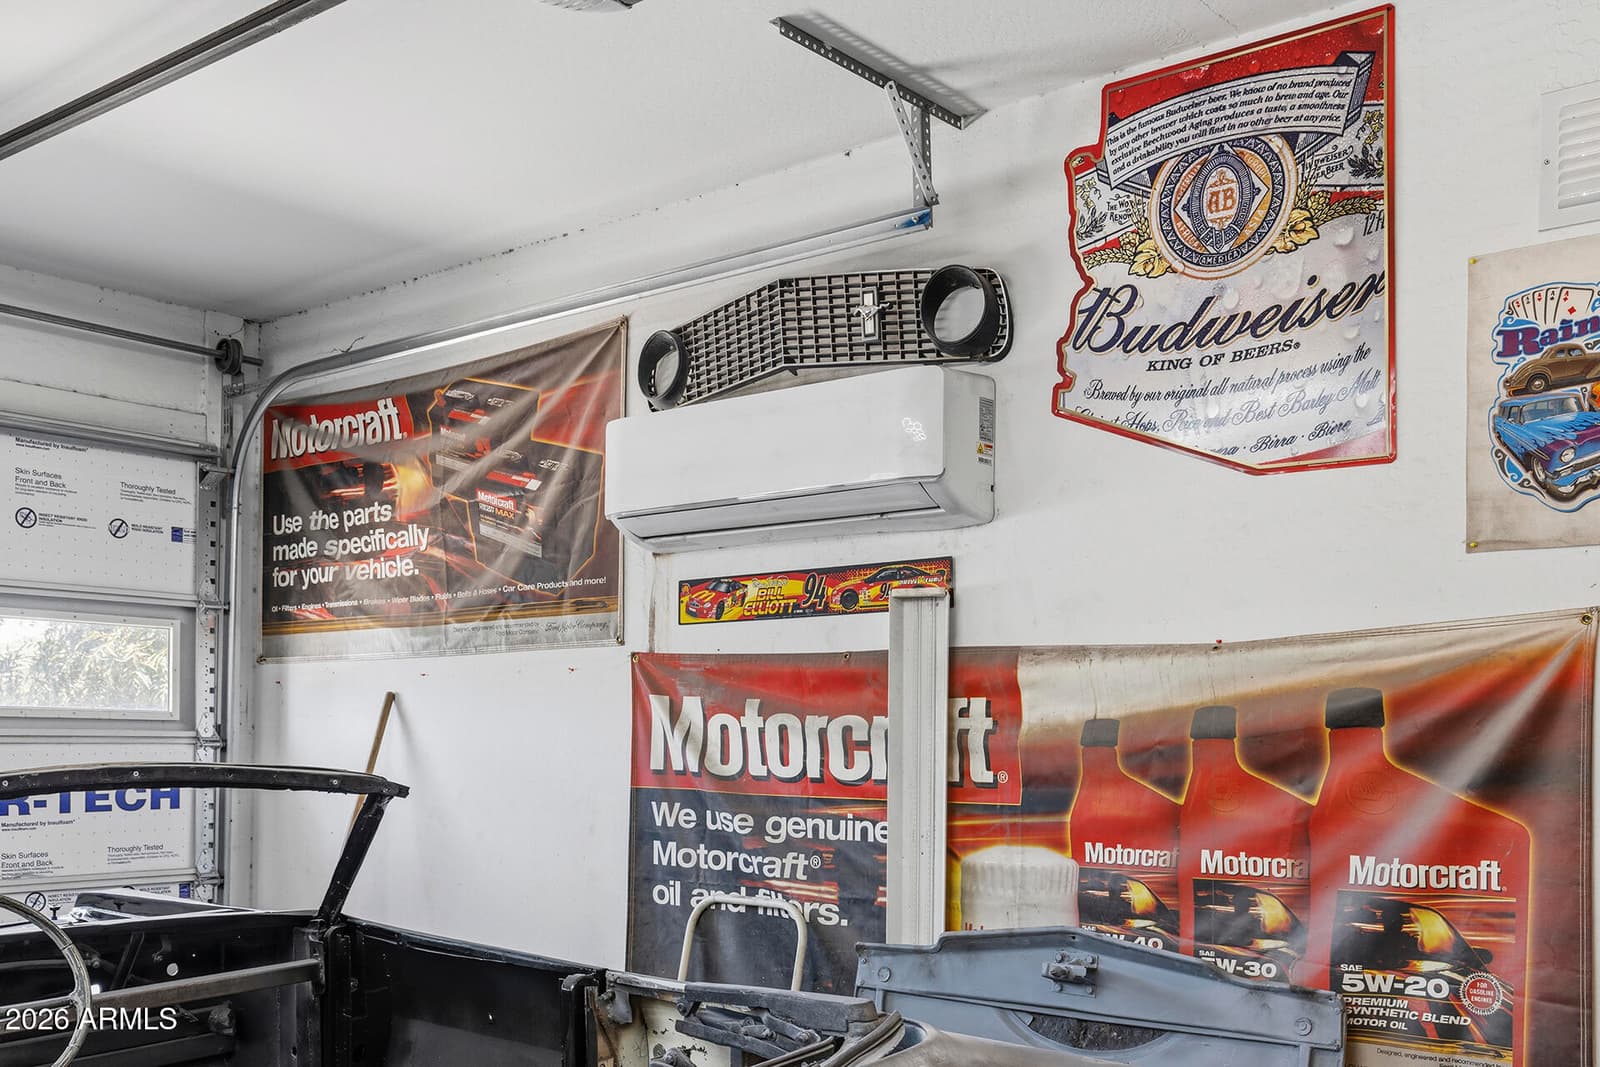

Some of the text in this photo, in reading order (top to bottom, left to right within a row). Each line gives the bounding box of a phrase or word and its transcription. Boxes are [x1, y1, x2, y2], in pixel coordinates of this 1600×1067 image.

[1106, 77, 1354, 148] This is the famous Budweiser beer. We know of no brand produced
[1109, 89, 1349, 157] by any other brewer which costs so much to brew and age. Our
[1111, 144, 1142, 166] exclusive
[1143, 126, 1188, 149] Beechwood
[1188, 114, 1213, 132] Aging
[1212, 106, 1256, 127] produces
[1265, 101, 1289, 113] taste,
[1290, 103, 1298, 111] a
[1298, 100, 1346, 111] smoothness
[1112, 161, 1127, 175] and
[1132, 138, 1175, 165] drinkability
[1174, 135, 1191, 151] you
[1191, 127, 1209, 143] will
[1208, 122, 1227, 137] find
[1227, 119, 1238, 131] in
[1237, 118, 1249, 129] no
[1249, 112, 1272, 128] other
[1273, 110, 1295, 123] beer
[1294, 112, 1305, 122] at
[1304, 112, 1321, 124] any
[1319, 111, 1343, 123] price.
[1106, 201, 1118, 212] THE
[1200, 249, 1241, 265] AMERICA
[1071, 269, 1385, 354] Budweiser
[1145, 358, 1193, 371] KING
[1199, 353, 1225, 367] OF
[1083, 341, 1372, 409] Brewed by our original all natural process using the
[1231, 399, 1278, 426] Best
[1277, 388, 1336, 418] Barley
[1250, 433, 1298, 454] Birra
[15, 466, 63, 481] Skin Surfaces
[15, 475, 67, 490] Front and Back
[119, 481, 177, 496] Thoroughly Tested
[272, 501, 393, 536] Use the parts
[272, 523, 430, 562] made specifically
[272, 554, 420, 591] for your vehicle.
[282, 603, 299, 612] Filters
[301, 601, 322, 611] Engines
[324, 598, 359, 610] Transmissions
[502, 584, 516, 593] Car
[517, 581, 536, 592] Care
[537, 579, 569, 590] Products
[569, 577, 583, 587] and
[584, 575, 607, 586] more!
[755, 585, 786, 601] BILL
[801, 572, 827, 610] 94
[742, 598, 798, 617] ELLIOTT
[1, 820, 47, 829] Manufactured by
[651, 800, 889, 844] We use genuine
[1, 850, 49, 862] Skin Surfaces
[107, 843, 164, 854] Thoroughly Tested
[21, 859, 35, 868] and
[36, 857, 53, 867] Back
[652, 879, 682, 907] oil
[690, 886, 747, 914] and
[1199, 949, 1217, 958] SAE
[1200, 956, 1277, 978] W-30
[1340, 963, 1364, 972] SAE
[1341, 972, 1451, 999] 5W-20
[1469, 988, 1495, 997] GASOLINE
[1476, 981, 1488, 989] FOR
[1342, 996, 1409, 1009] PREMIUM
[1471, 995, 1493, 1004] ENGINES
[1345, 1005, 1472, 1027] SYNTHETIC BLEND
[1389, 1020, 1409, 1031] OIL
[1376, 1047, 1403, 1058] Designed,
[1404, 1051, 1438, 1062] engineered
[1438, 1056, 1451, 1064] and
